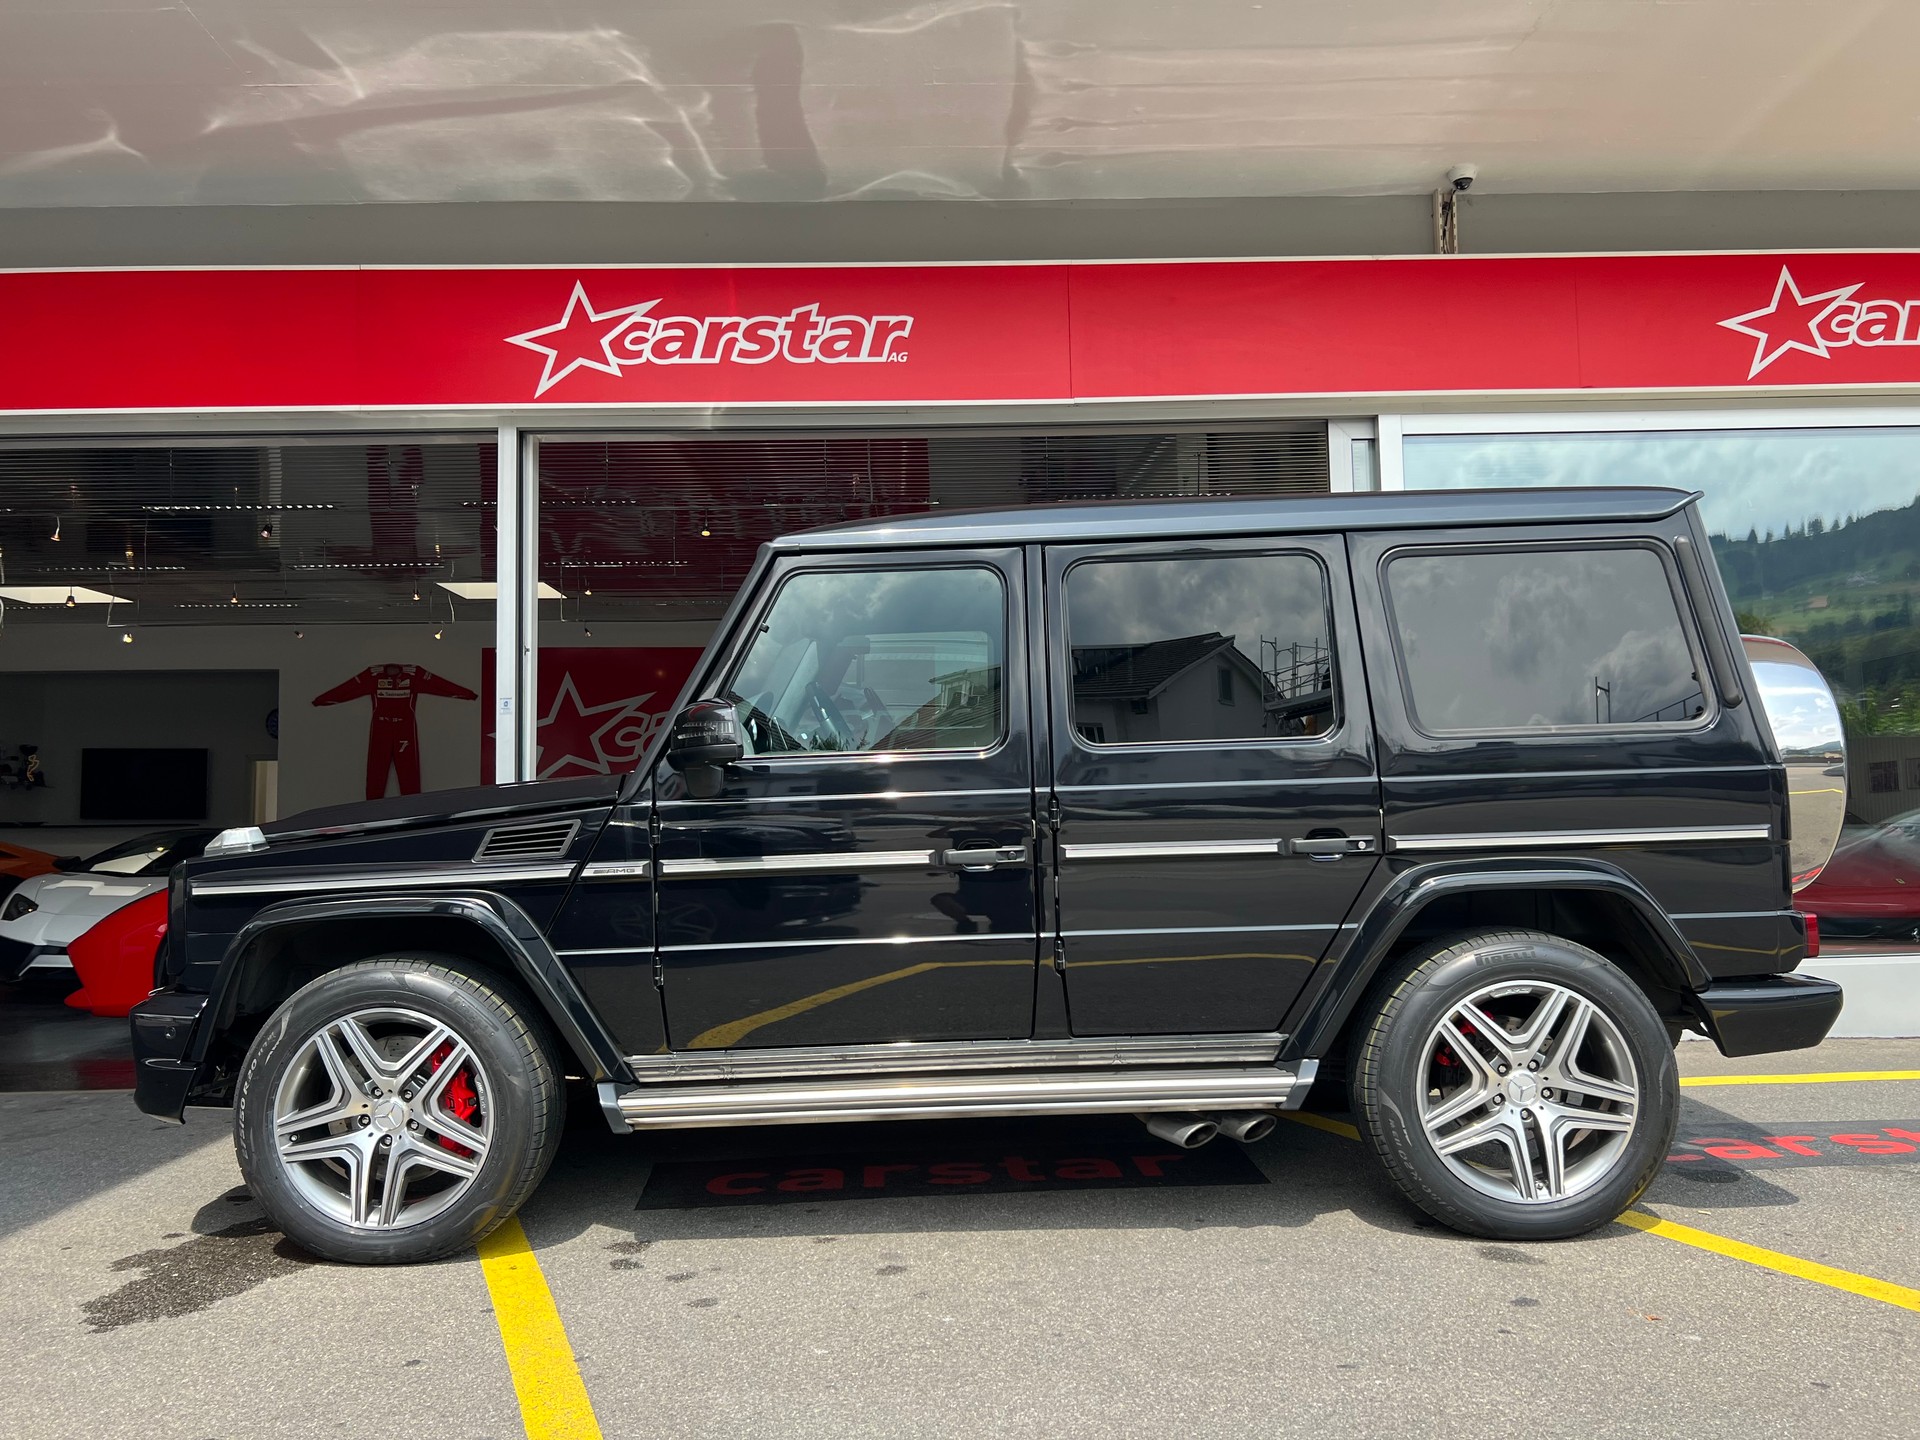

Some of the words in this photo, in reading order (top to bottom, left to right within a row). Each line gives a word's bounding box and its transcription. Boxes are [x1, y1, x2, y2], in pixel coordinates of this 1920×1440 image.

[600, 302, 914, 366] carstar
[888, 351, 909, 364] AG
[399, 740, 409, 753] 7
[705, 1153, 1187, 1196] carstar
